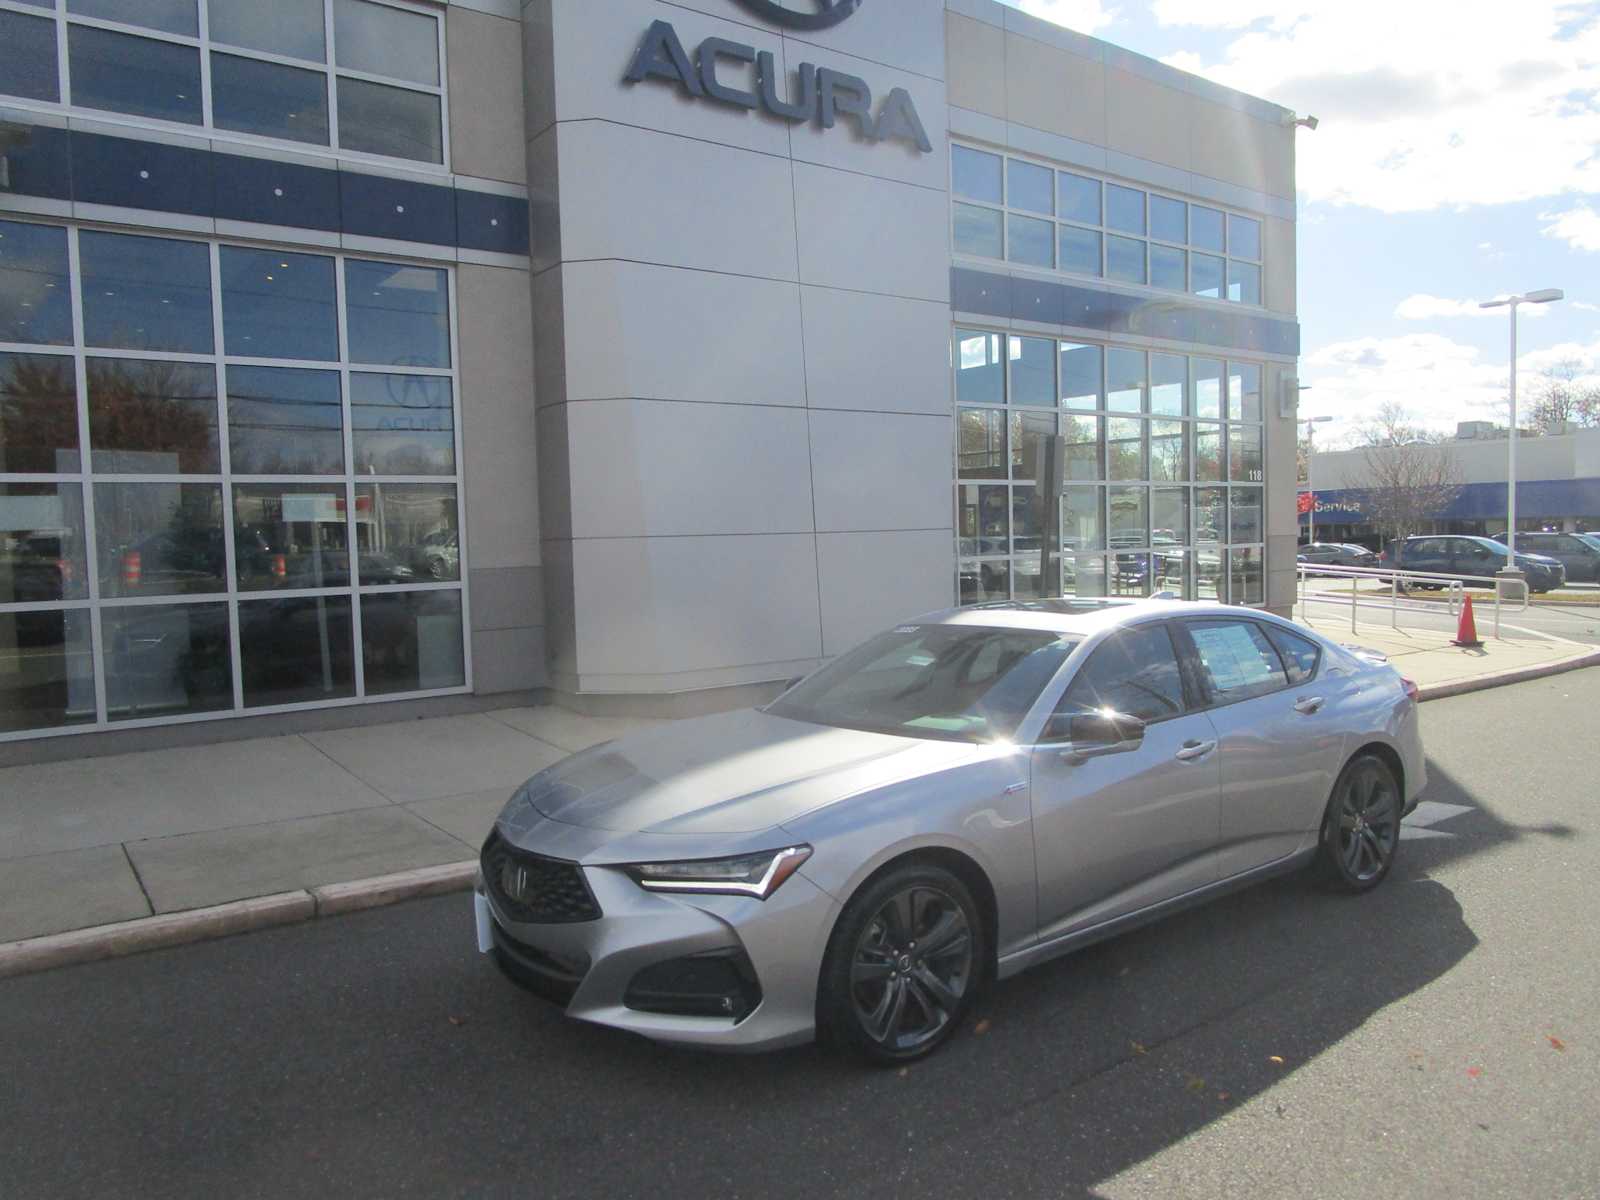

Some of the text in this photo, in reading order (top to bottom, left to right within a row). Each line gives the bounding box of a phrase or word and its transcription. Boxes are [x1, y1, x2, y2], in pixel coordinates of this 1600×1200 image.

[622, 19, 933, 153] ACURA
[1249, 470, 1262, 481] 118
[1314, 500, 1361, 512] Service
